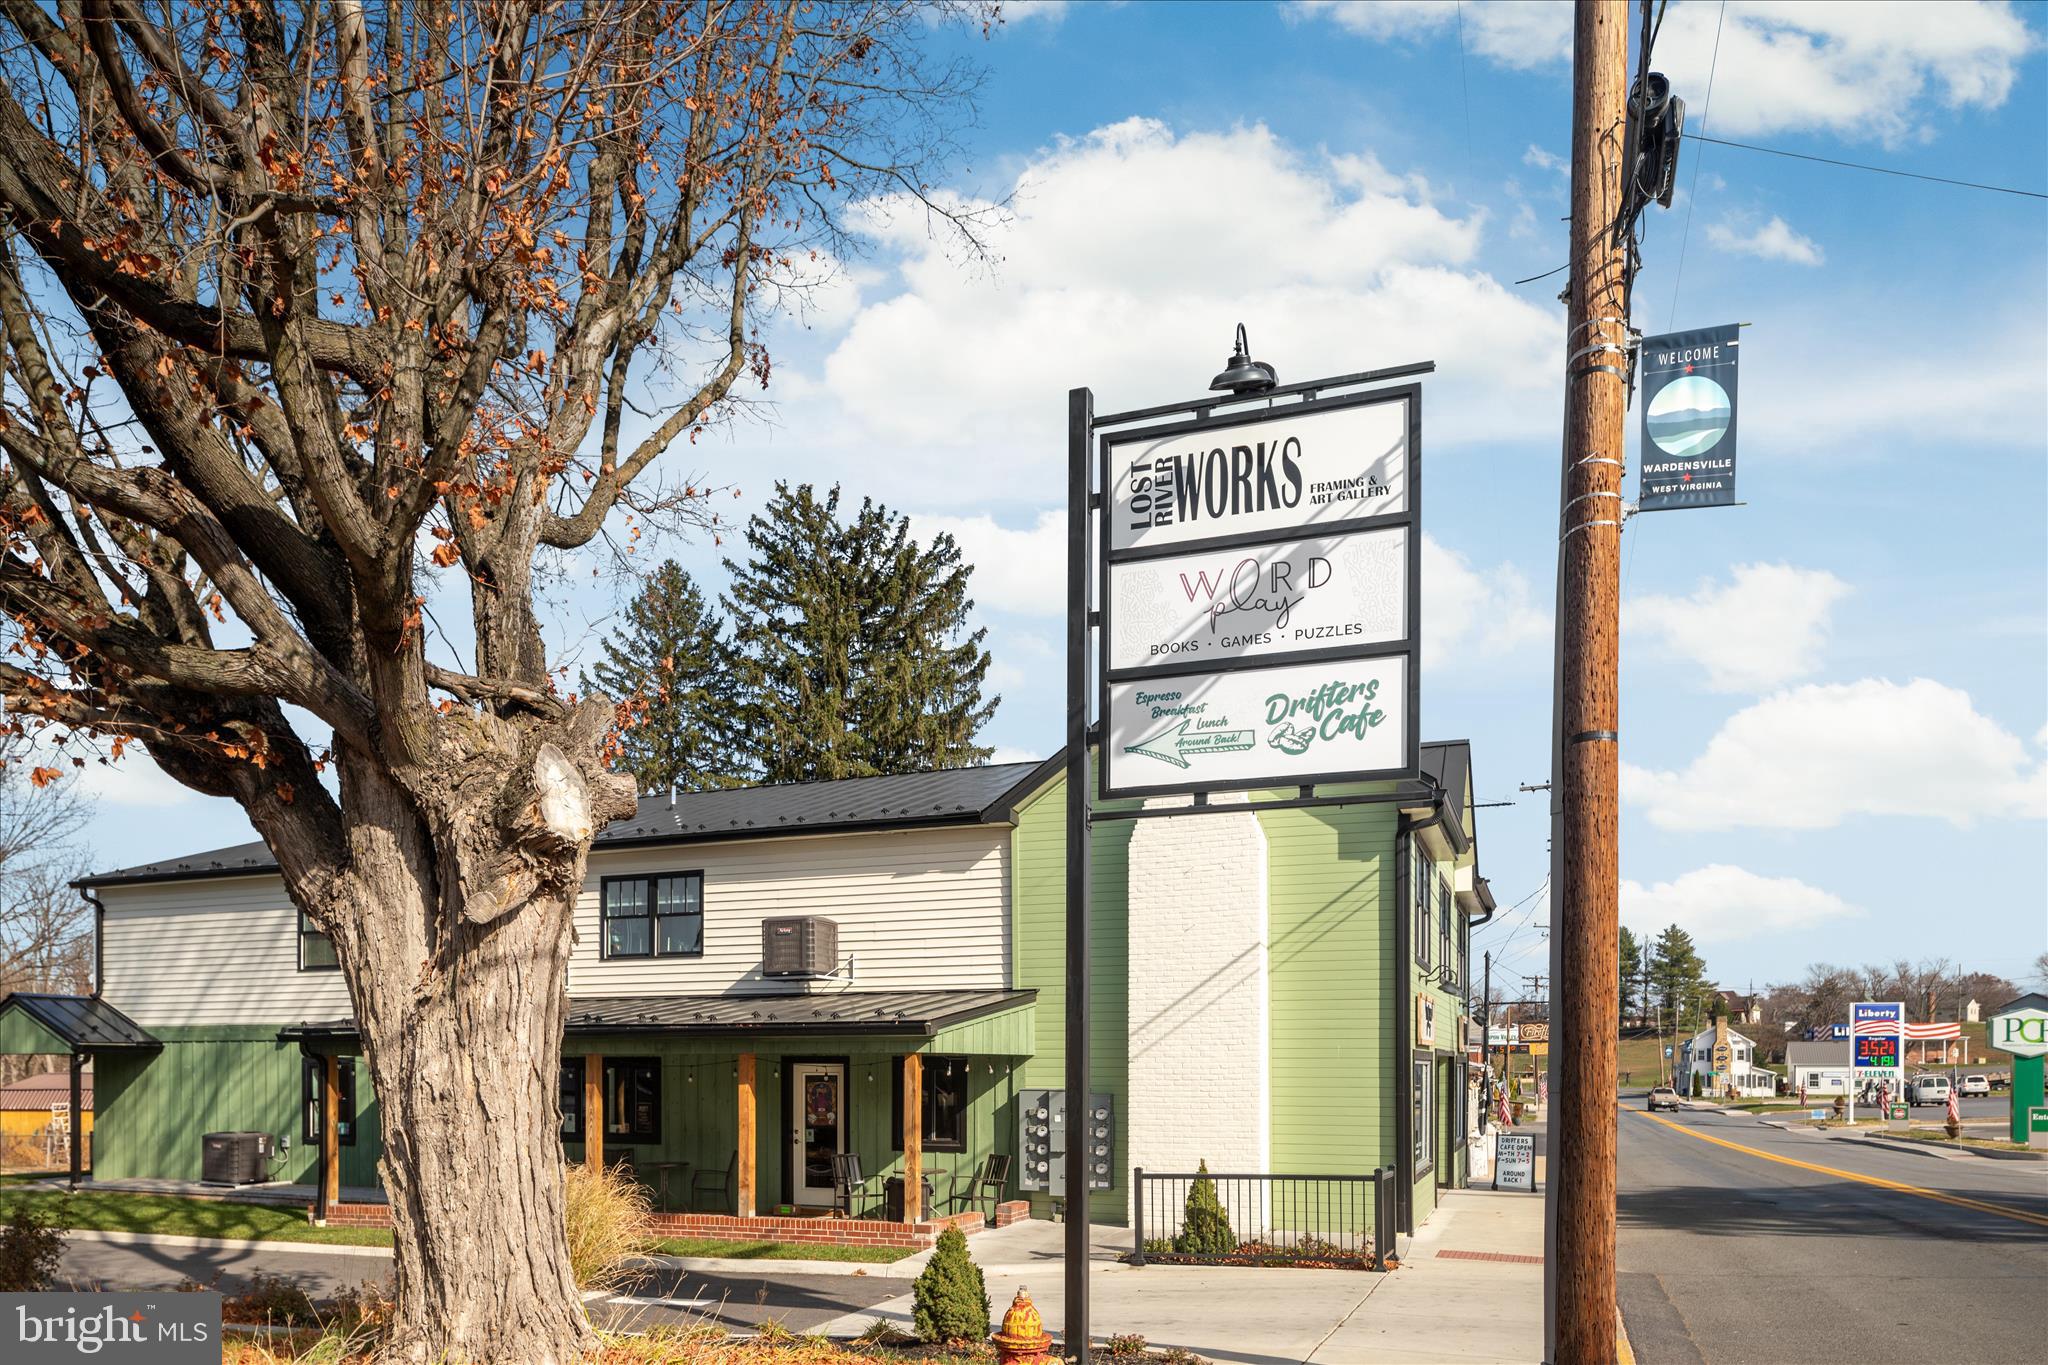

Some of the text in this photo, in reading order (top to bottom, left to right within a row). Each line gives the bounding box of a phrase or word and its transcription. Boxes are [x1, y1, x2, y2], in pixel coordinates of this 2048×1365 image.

[1658, 346, 1719, 366] WELCOME
[1643, 459, 1732, 473] WARDENSVILLE
[1173, 436, 1302, 522] WORKS
[1310, 475, 1378, 493] FRAMING &
[1652, 481, 1722, 493] WEST VIRGINIA
[1130, 461, 1152, 530] LOST
[1154, 456, 1174, 527] RIVER
[1309, 485, 1391, 505] ART GALLERY
[1179, 557, 1332, 603] WORD
[1150, 623, 1363, 656] BOOKS GAMES PUZZLES
[1135, 691, 1182, 707] Espresso
[1265, 678, 1380, 725] Drifters
[1151, 702, 1208, 719] Breakfast
[1196, 715, 1228, 730] Lunch
[1320, 702, 1387, 741] Cafe
[1175, 733, 1241, 748] Around Back!
[1858, 1009, 1896, 1019] Liberty
[2032, 1112, 2048, 1121] Ent
